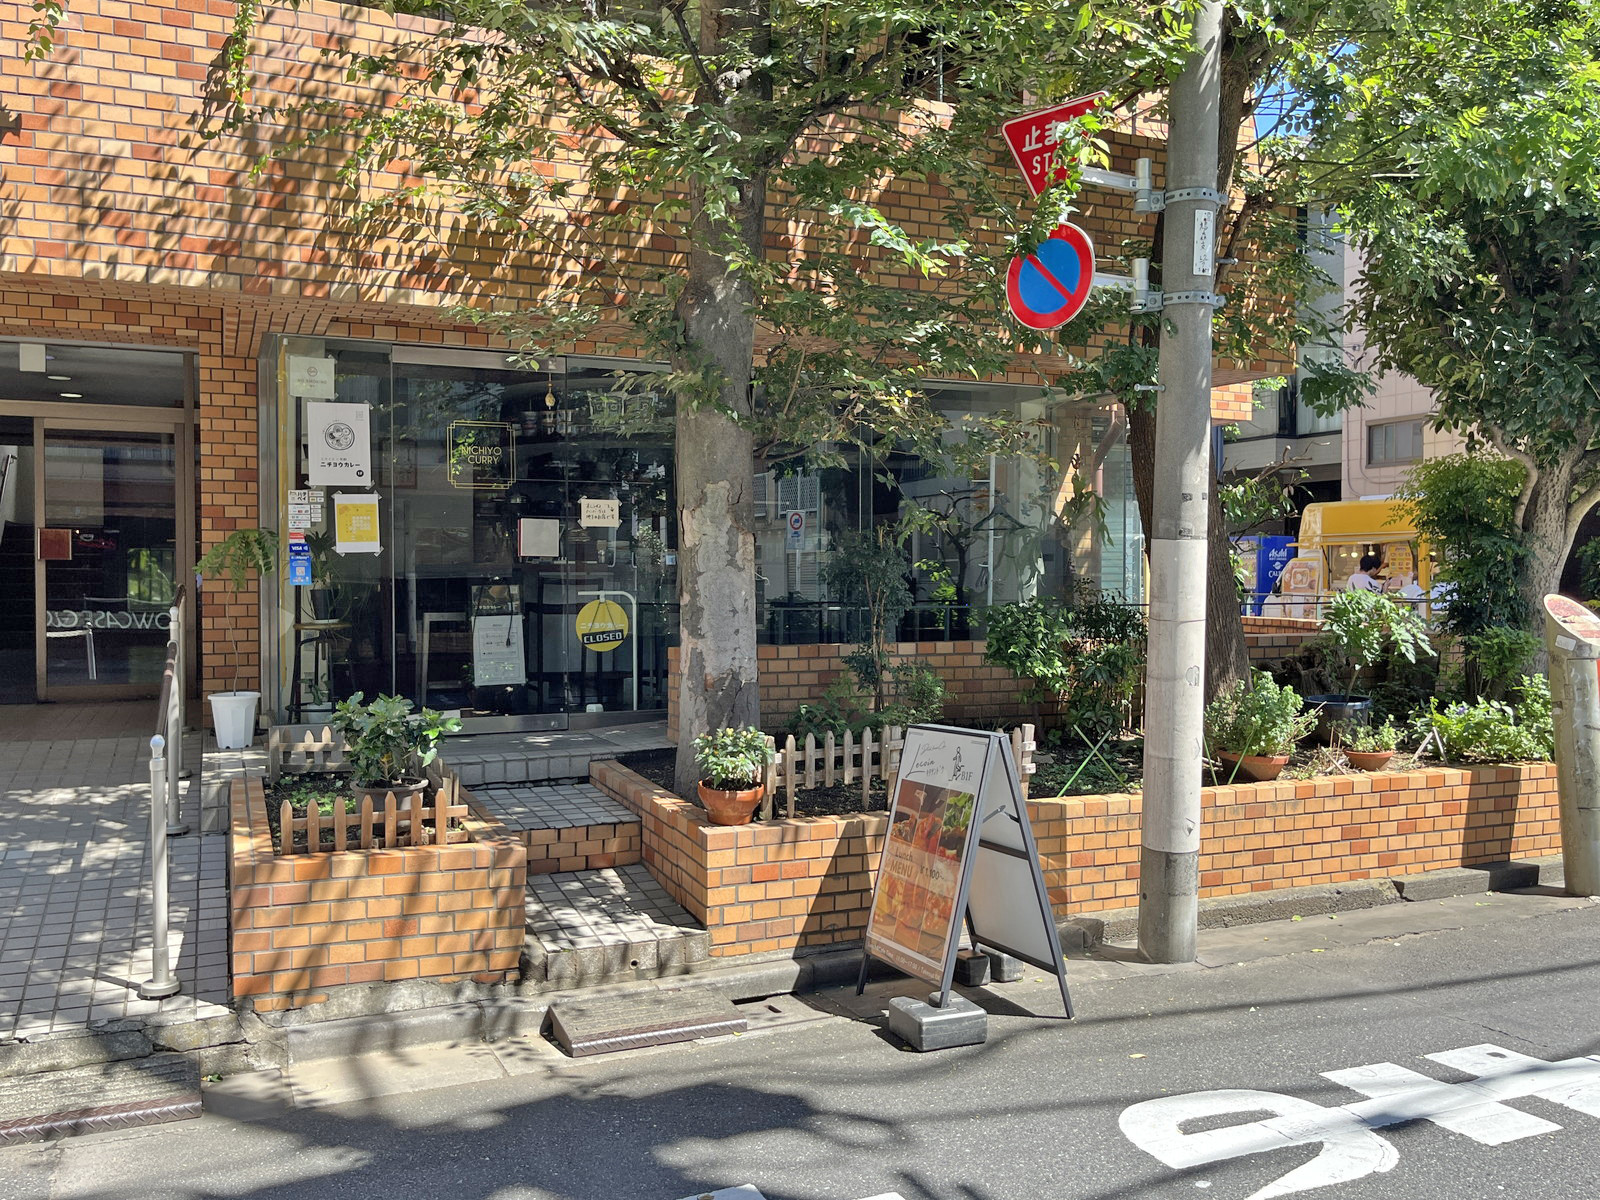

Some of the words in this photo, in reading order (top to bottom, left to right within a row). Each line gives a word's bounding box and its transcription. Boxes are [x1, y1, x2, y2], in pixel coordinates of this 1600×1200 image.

[1021, 114, 1078, 153] 止ま
[461, 445, 502, 456] NICHIYO
[467, 455, 499, 465] CURRY
[1268, 548, 1288, 557] Asahi
[583, 632, 623, 644] CLOSED
[895, 846, 913, 861] Lunch
[890, 860, 914, 878] MENU
